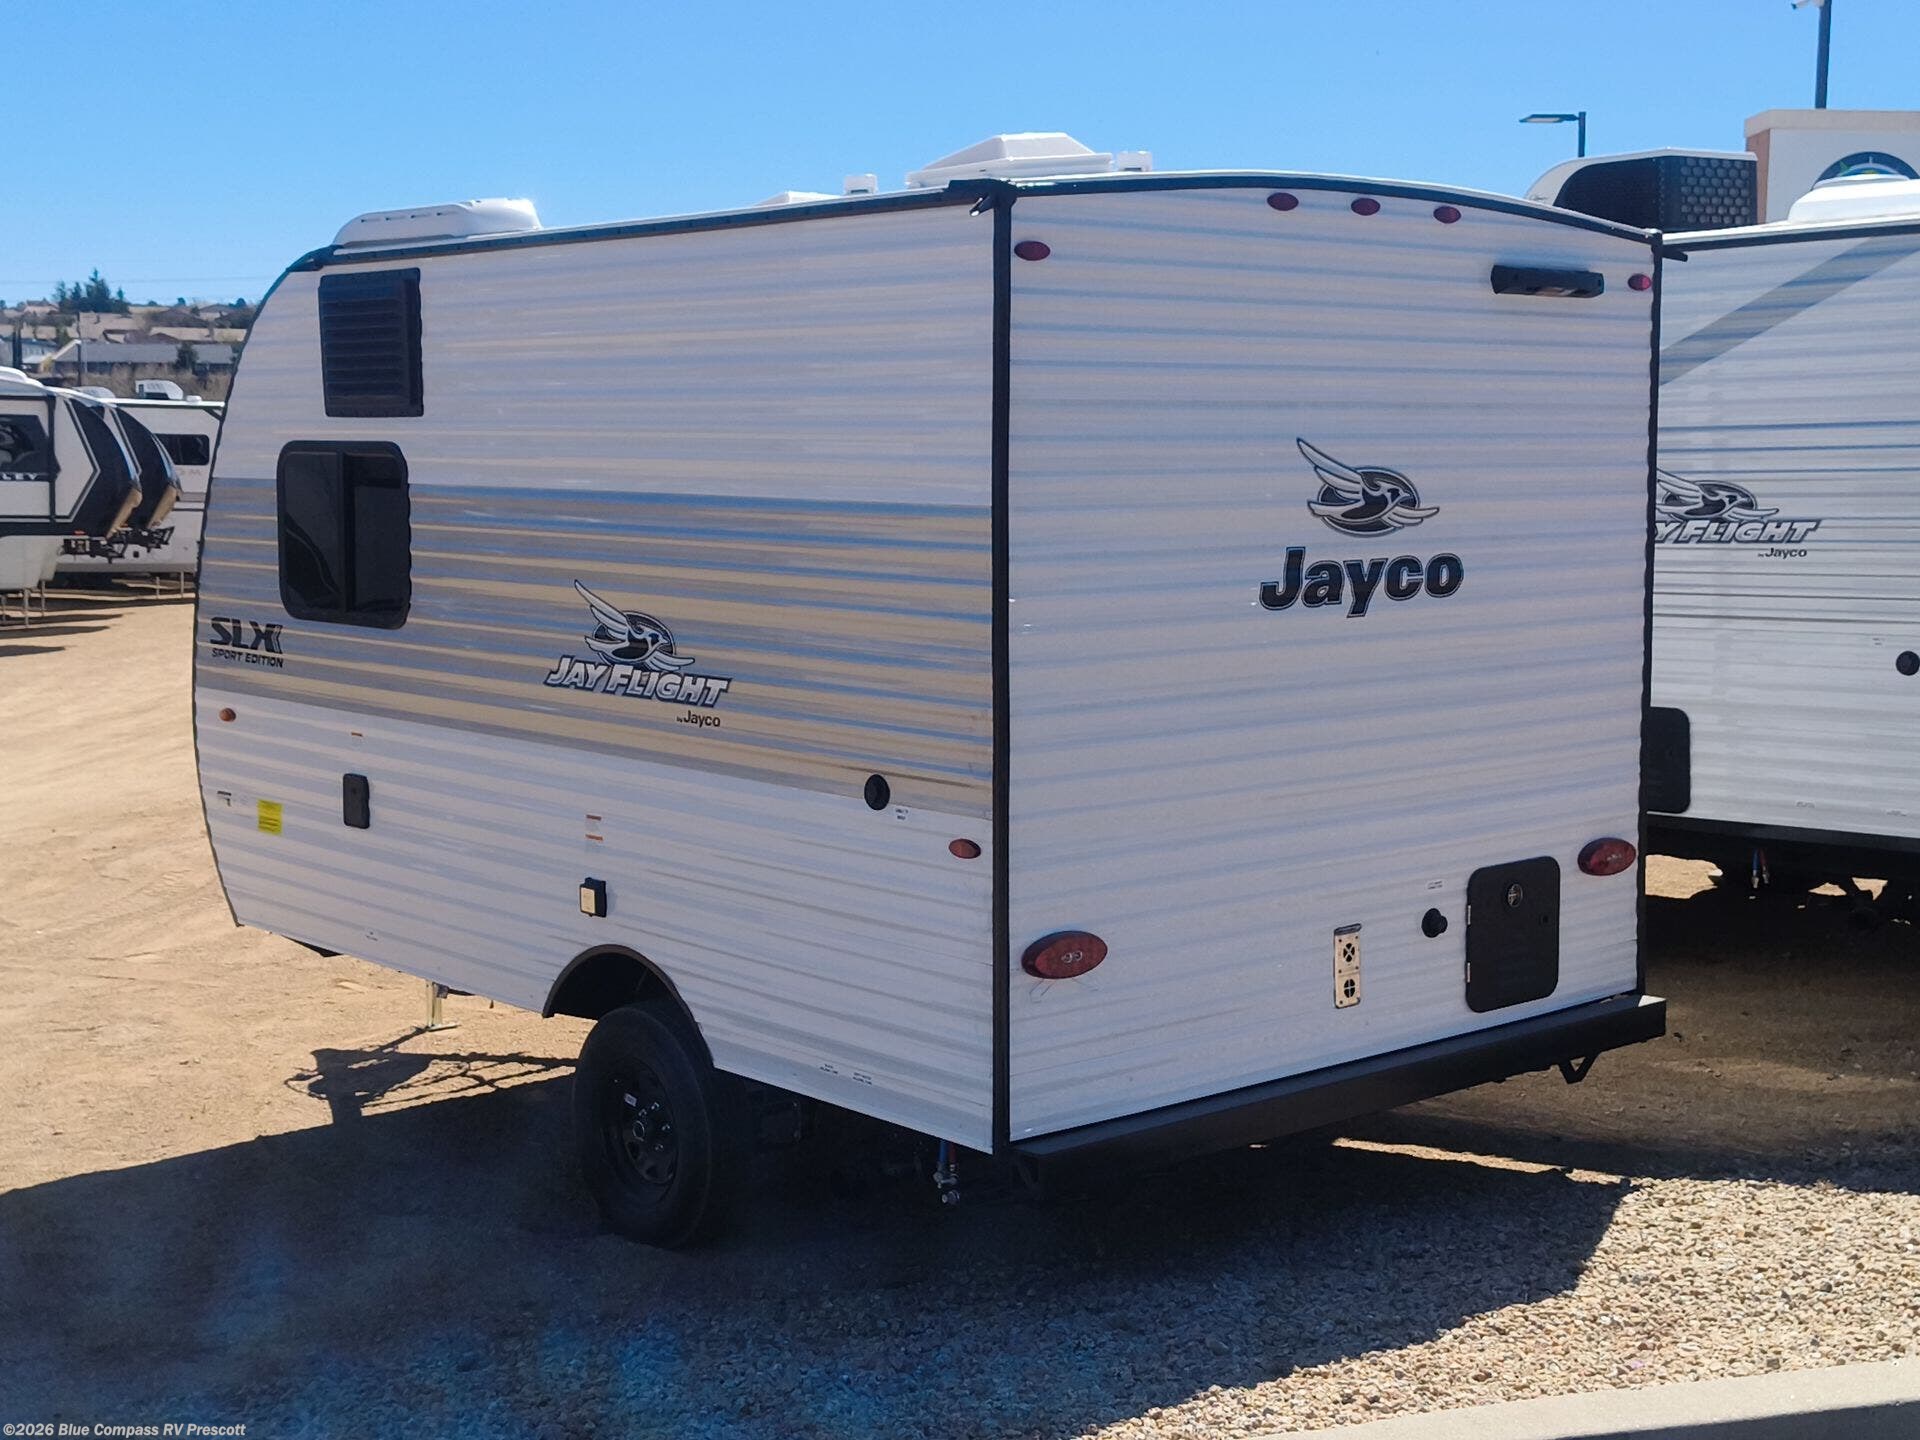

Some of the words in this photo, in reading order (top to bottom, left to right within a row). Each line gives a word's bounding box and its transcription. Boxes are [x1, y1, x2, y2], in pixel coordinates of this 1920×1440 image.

[1765, 547, 1807, 559] Jayco
[1259, 546, 1464, 618] Jayco
[210, 617, 283, 654] SLX
[212, 648, 243, 662] SPORT
[245, 652, 283, 668] EDITION
[543, 655, 608, 691] JAY
[603, 664, 732, 708] FLIGHT
[684, 710, 720, 728] Jayco
